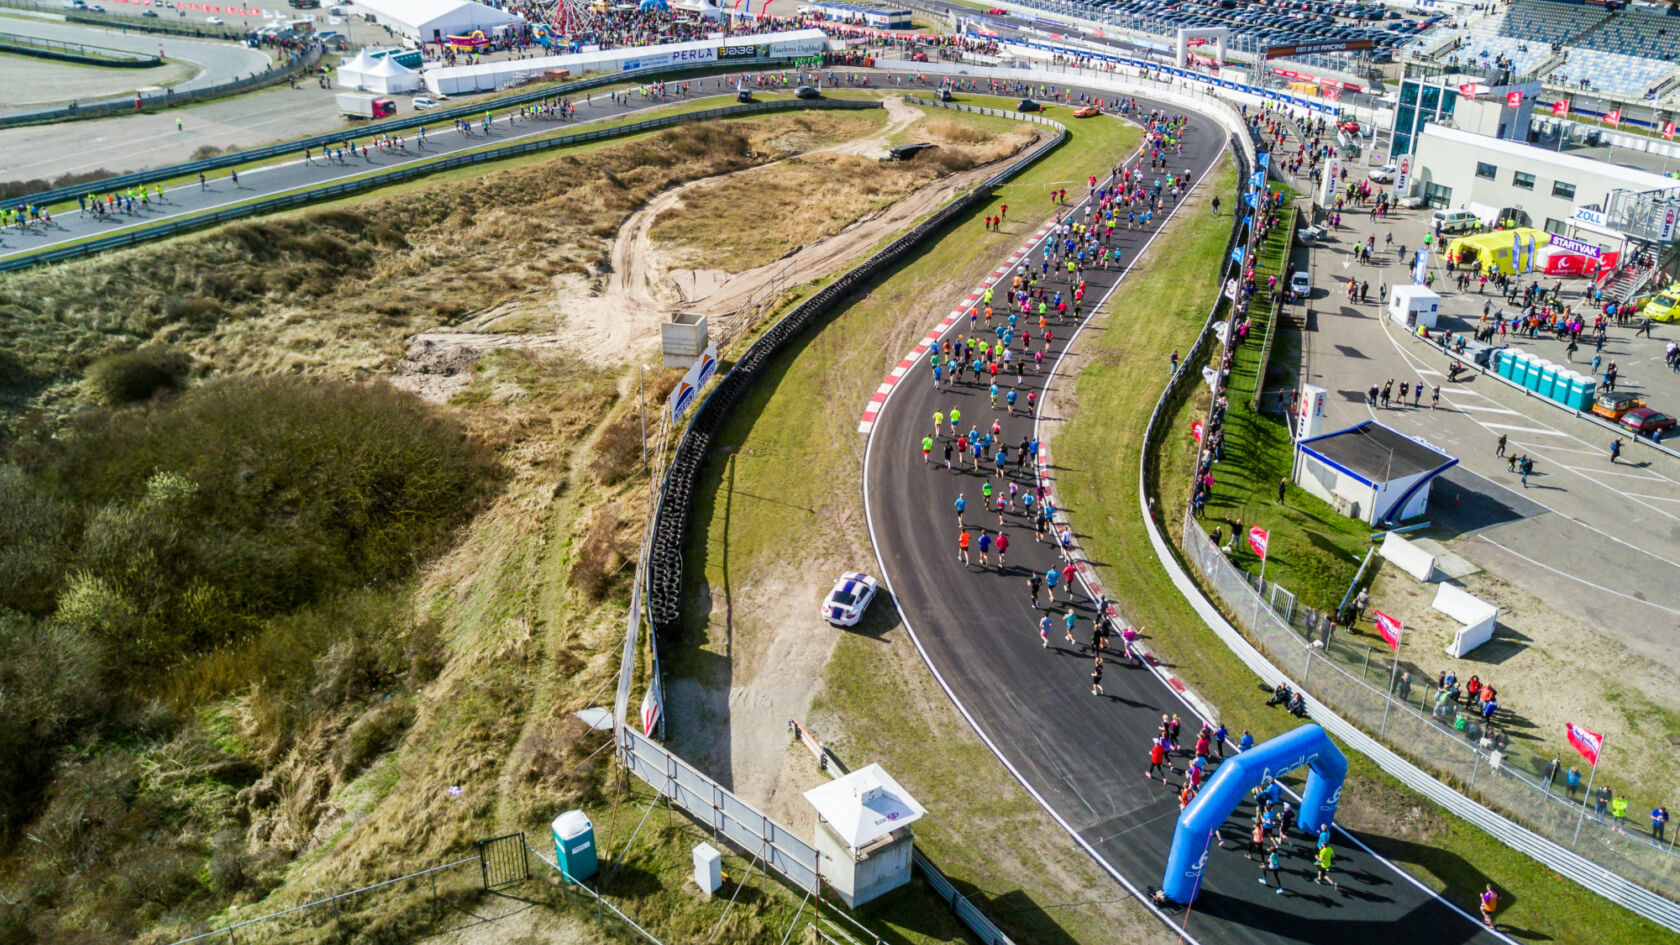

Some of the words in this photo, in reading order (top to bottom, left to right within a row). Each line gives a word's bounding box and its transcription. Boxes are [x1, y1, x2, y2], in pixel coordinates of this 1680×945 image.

[673, 48, 713, 61] PERLA
[1576, 209, 1601, 224] ZOLL
[1552, 236, 1598, 257] STARTVAK
